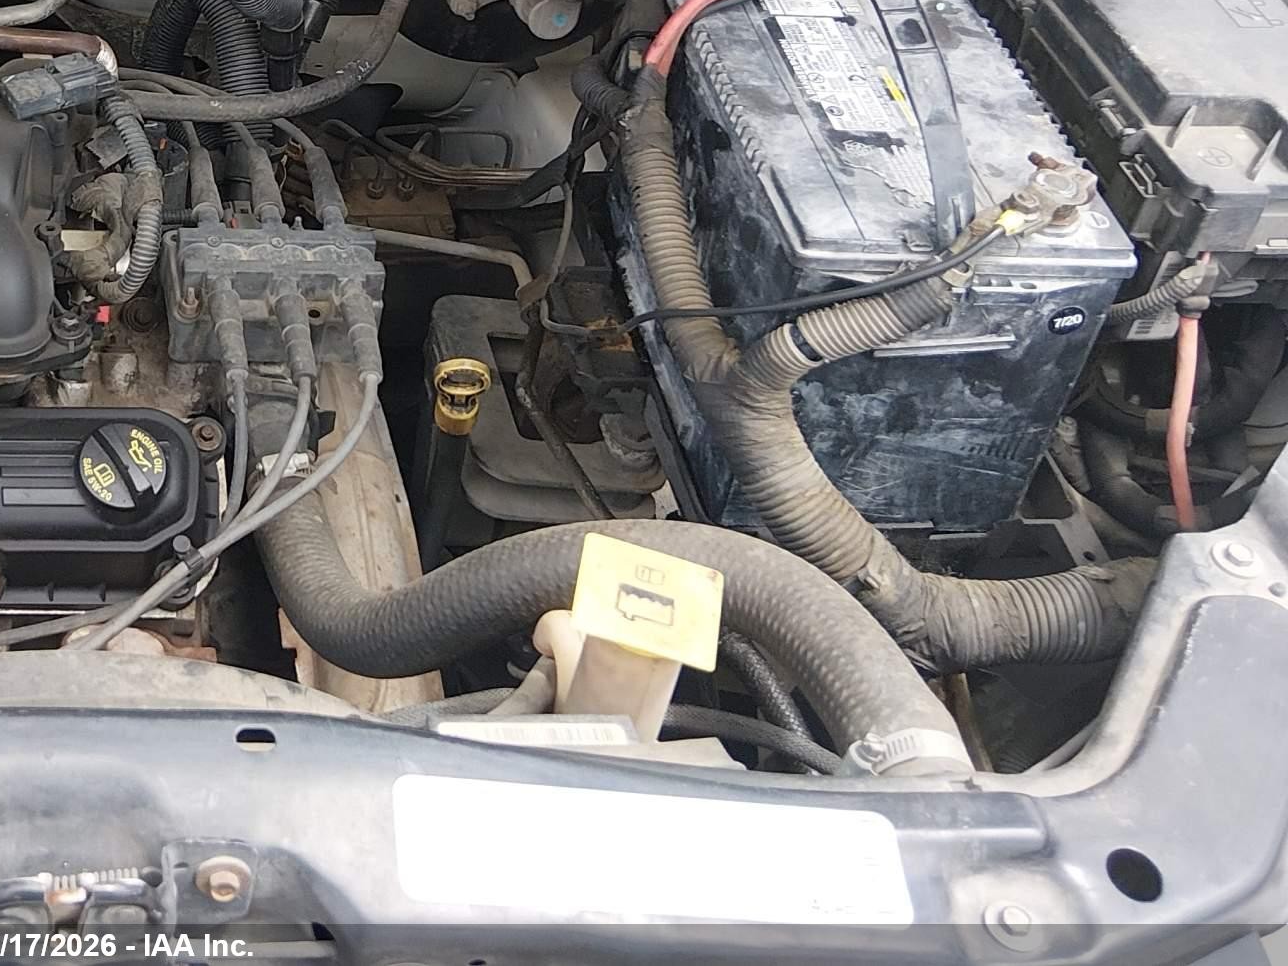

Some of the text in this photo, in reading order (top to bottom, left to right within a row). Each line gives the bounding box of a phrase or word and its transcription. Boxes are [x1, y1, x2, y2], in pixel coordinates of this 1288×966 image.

[1053, 313, 1084, 329] 7/20
[130, 428, 163, 475] ENGINE OIL
[82, 457, 113, 501] SAE 5W-20
